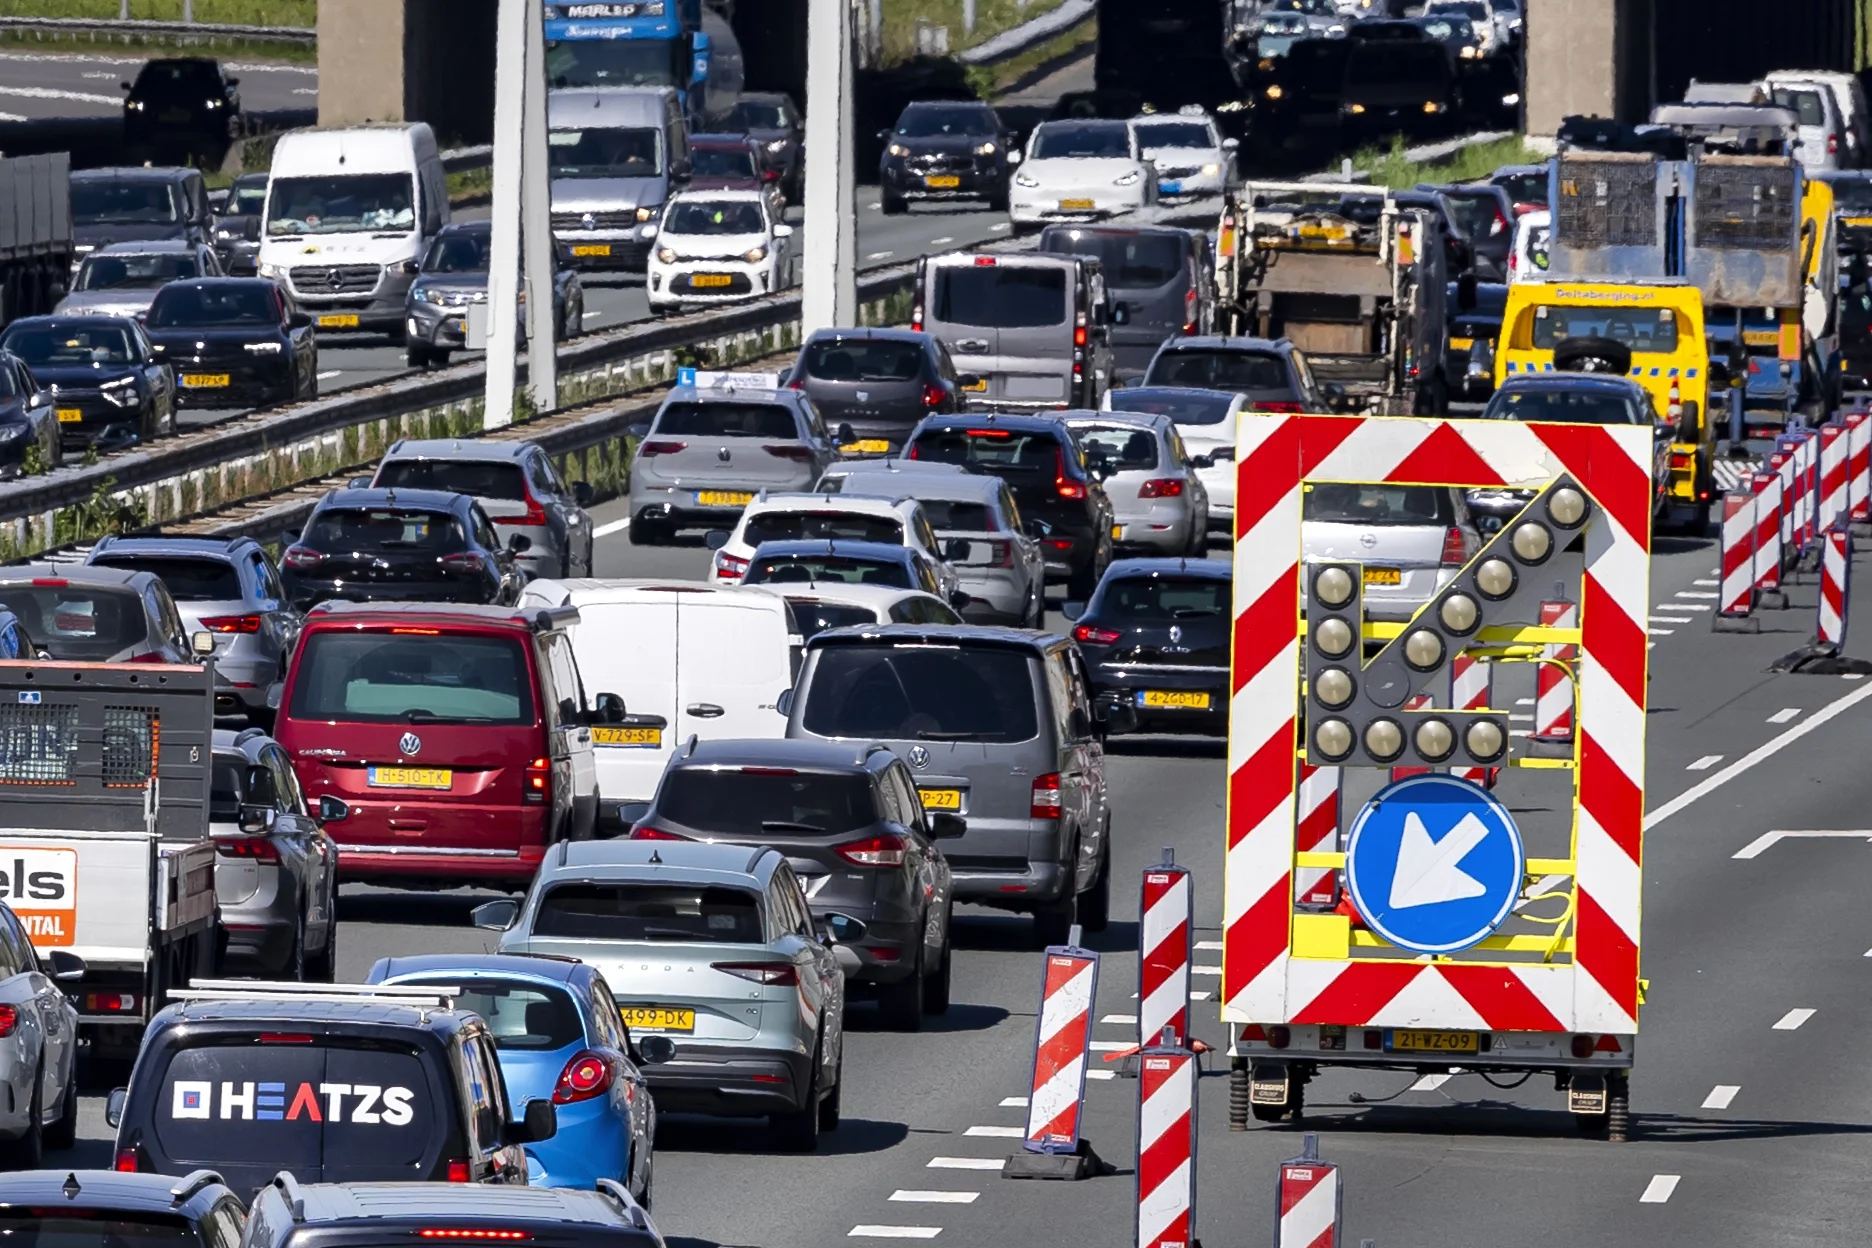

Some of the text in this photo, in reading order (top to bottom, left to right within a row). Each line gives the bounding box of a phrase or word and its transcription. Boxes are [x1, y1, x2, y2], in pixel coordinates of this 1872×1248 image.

[681, 371, 692, 384] L
[1150, 692, 1204, 705] 4-ZGD-17
[594, 729, 655, 742] V-729-SF
[382, 769, 444, 784] H-510-TK
[1400, 1032, 1471, 1049] 21-WZ-09
